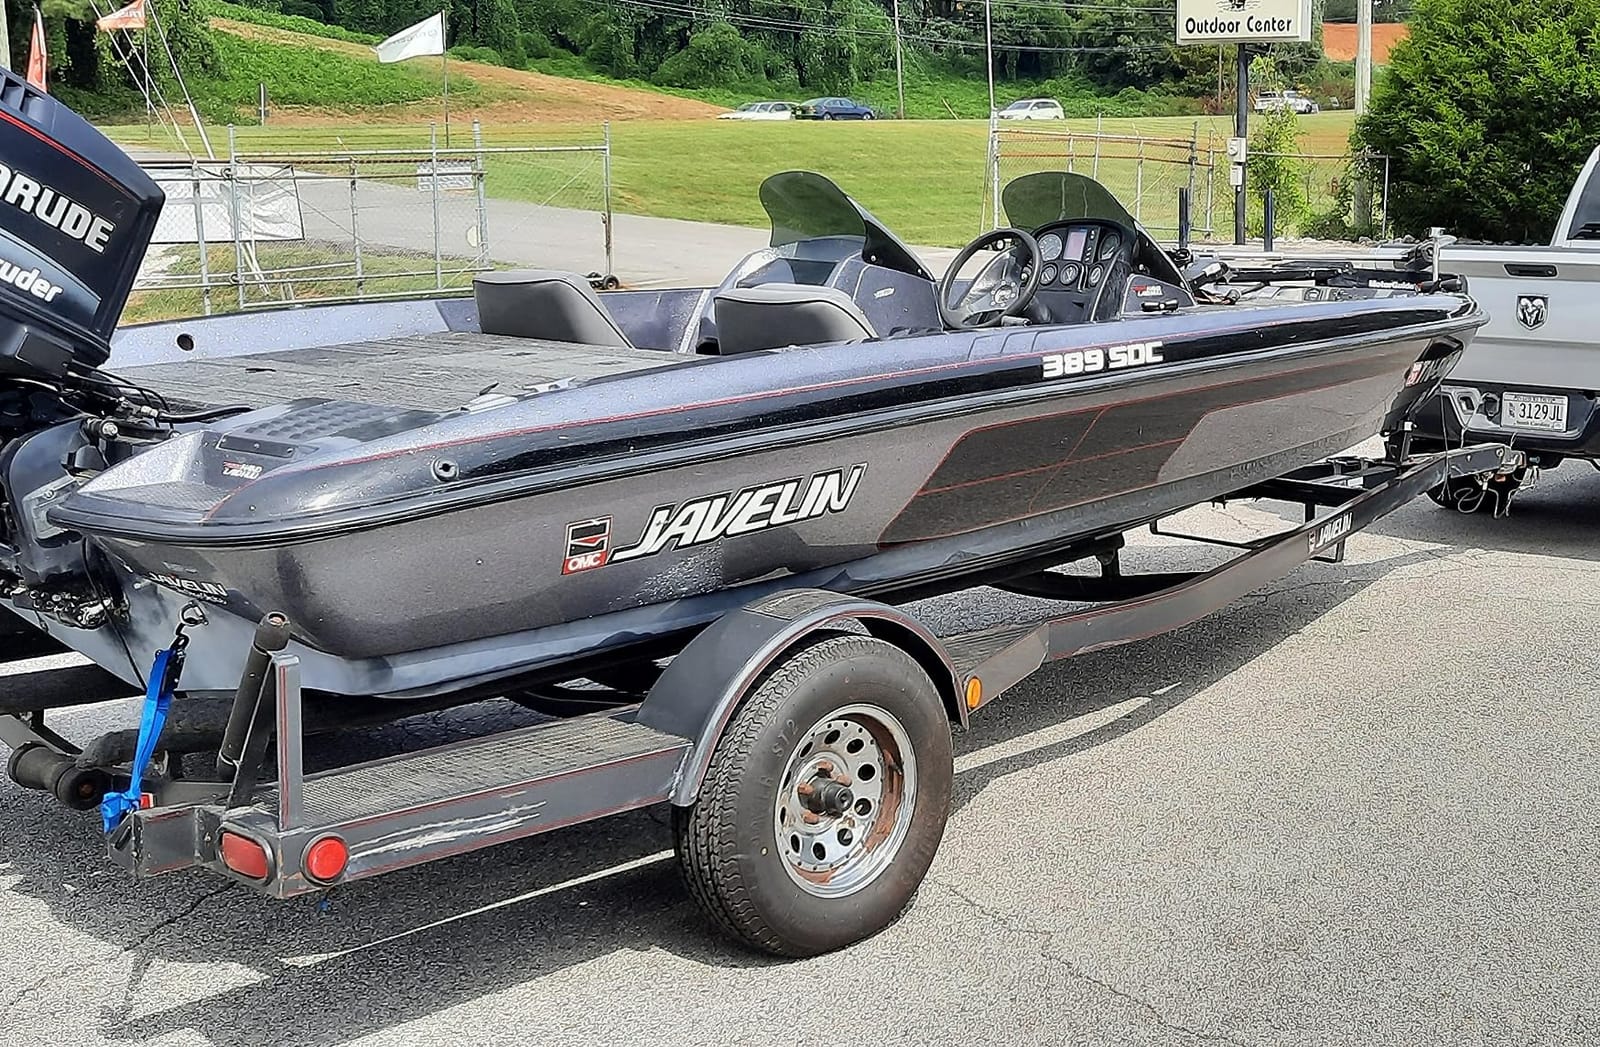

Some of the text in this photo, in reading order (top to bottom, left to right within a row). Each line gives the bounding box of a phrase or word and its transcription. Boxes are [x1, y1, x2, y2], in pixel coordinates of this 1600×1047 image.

[1185, 15, 1293, 34] Outdoor Center
[0, 258, 64, 302] uder
[1042, 348, 1105, 379] 389
[1518, 402, 1563, 421] 3129JL
[608, 465, 865, 563] JAVELIN
[567, 552, 603, 571] OMC
